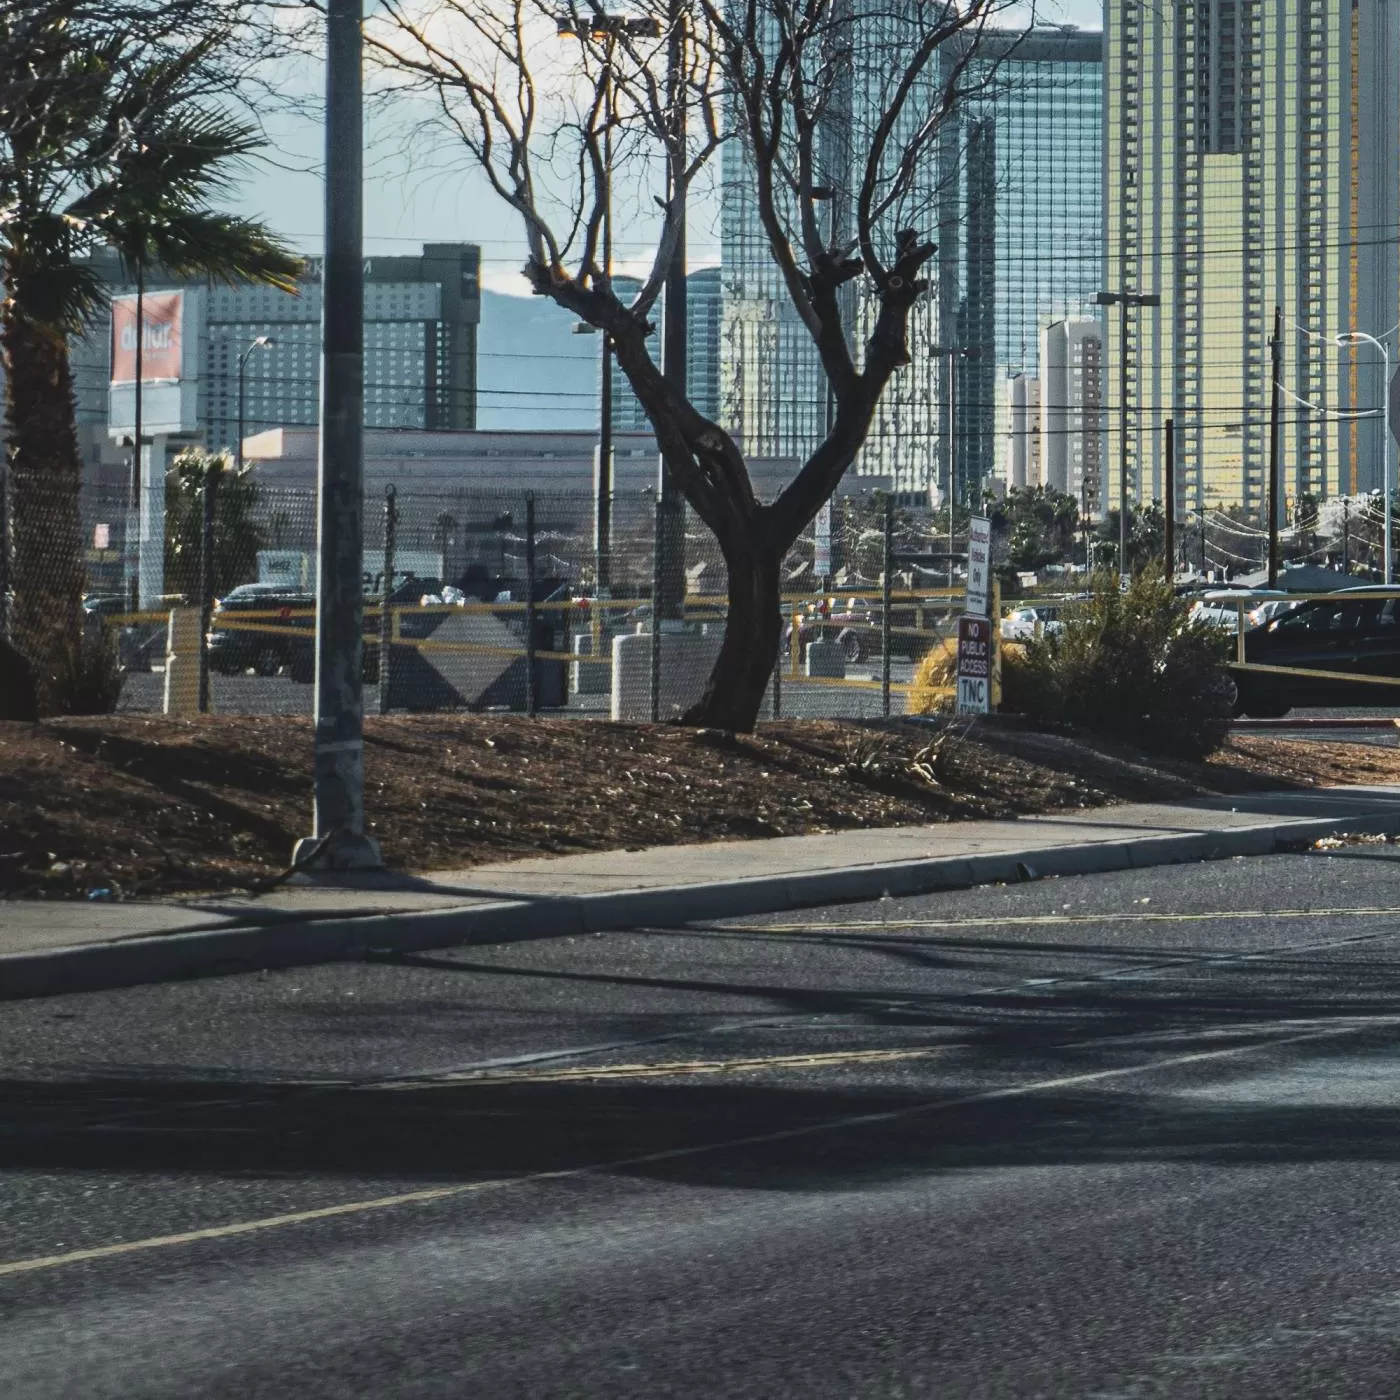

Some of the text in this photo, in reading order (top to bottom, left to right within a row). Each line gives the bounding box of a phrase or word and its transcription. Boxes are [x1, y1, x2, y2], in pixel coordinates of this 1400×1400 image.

[967, 622, 980, 638] NO
[961, 640, 987, 657] PUBLIC
[960, 659, 988, 675] ACCESS
[961, 679, 985, 703] TNC
